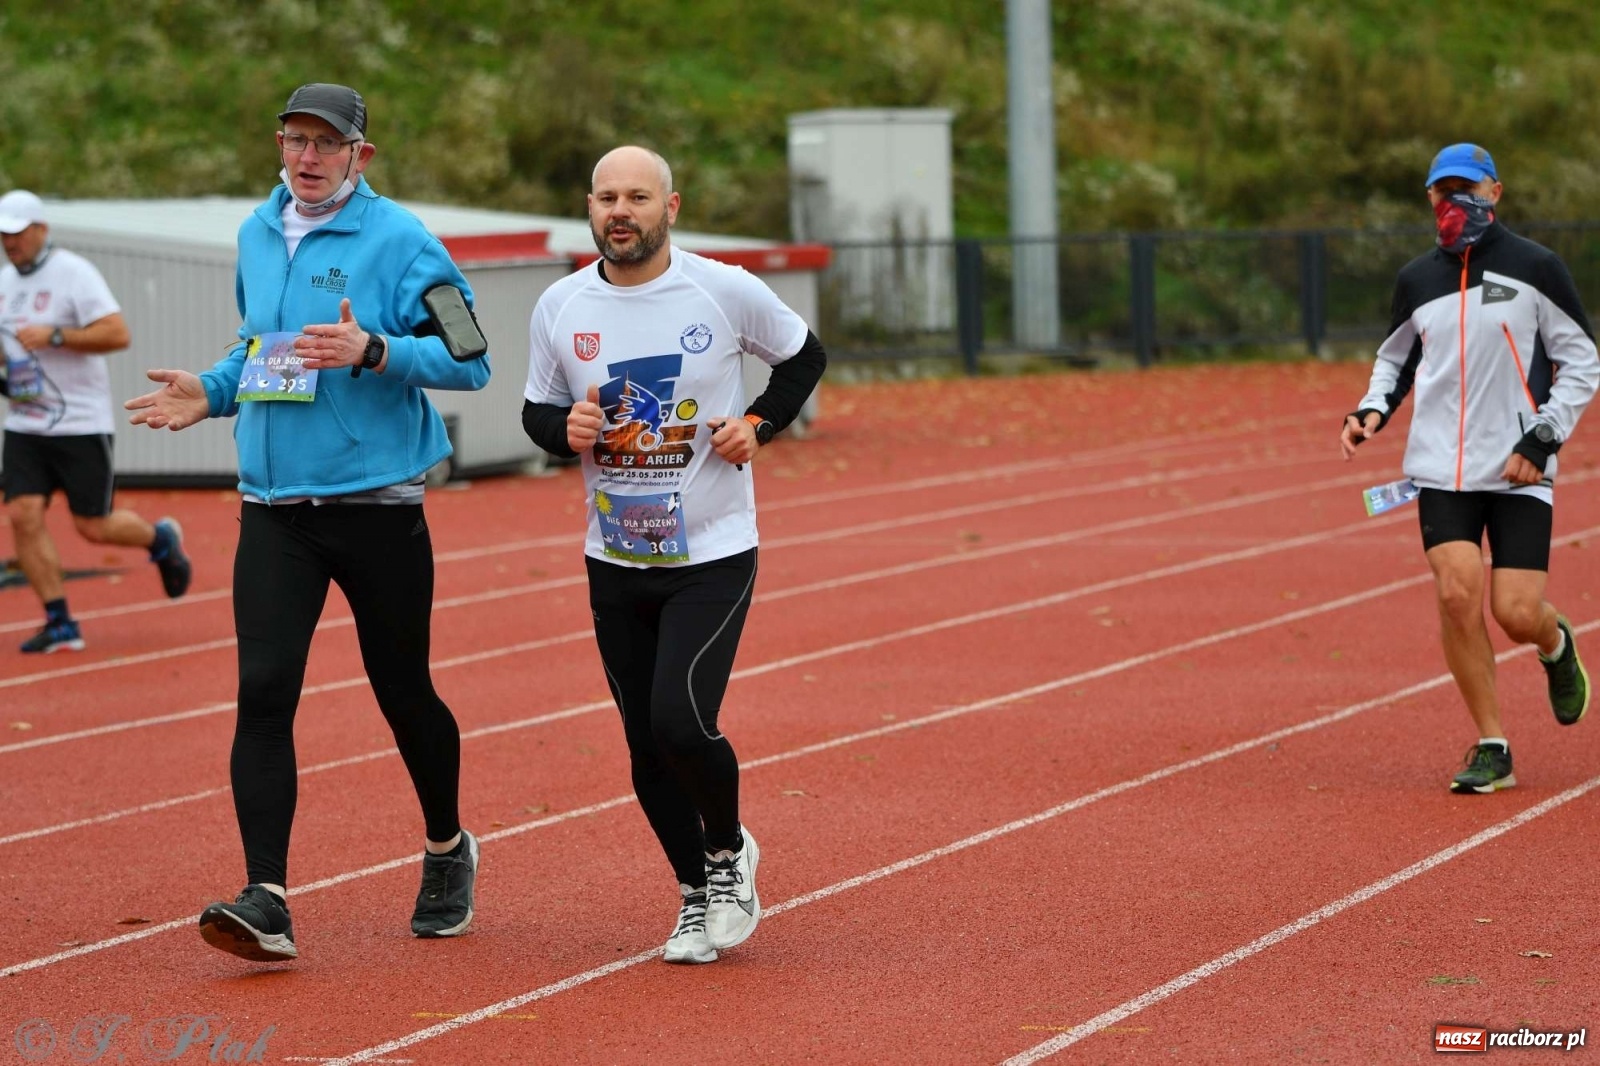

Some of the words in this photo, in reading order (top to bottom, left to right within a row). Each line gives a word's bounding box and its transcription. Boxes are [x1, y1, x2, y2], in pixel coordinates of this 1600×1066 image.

[328, 267, 341, 278] 10
[311, 275, 325, 285] VII
[268, 357, 281, 365] DLA
[278, 378, 307, 394] 295
[615, 455, 635, 466] BEZ
[637, 453, 684, 465] BARIER
[626, 470, 674, 479] 25.05.2019
[623, 519, 639, 528] DLA
[649, 540, 679, 554] 303
